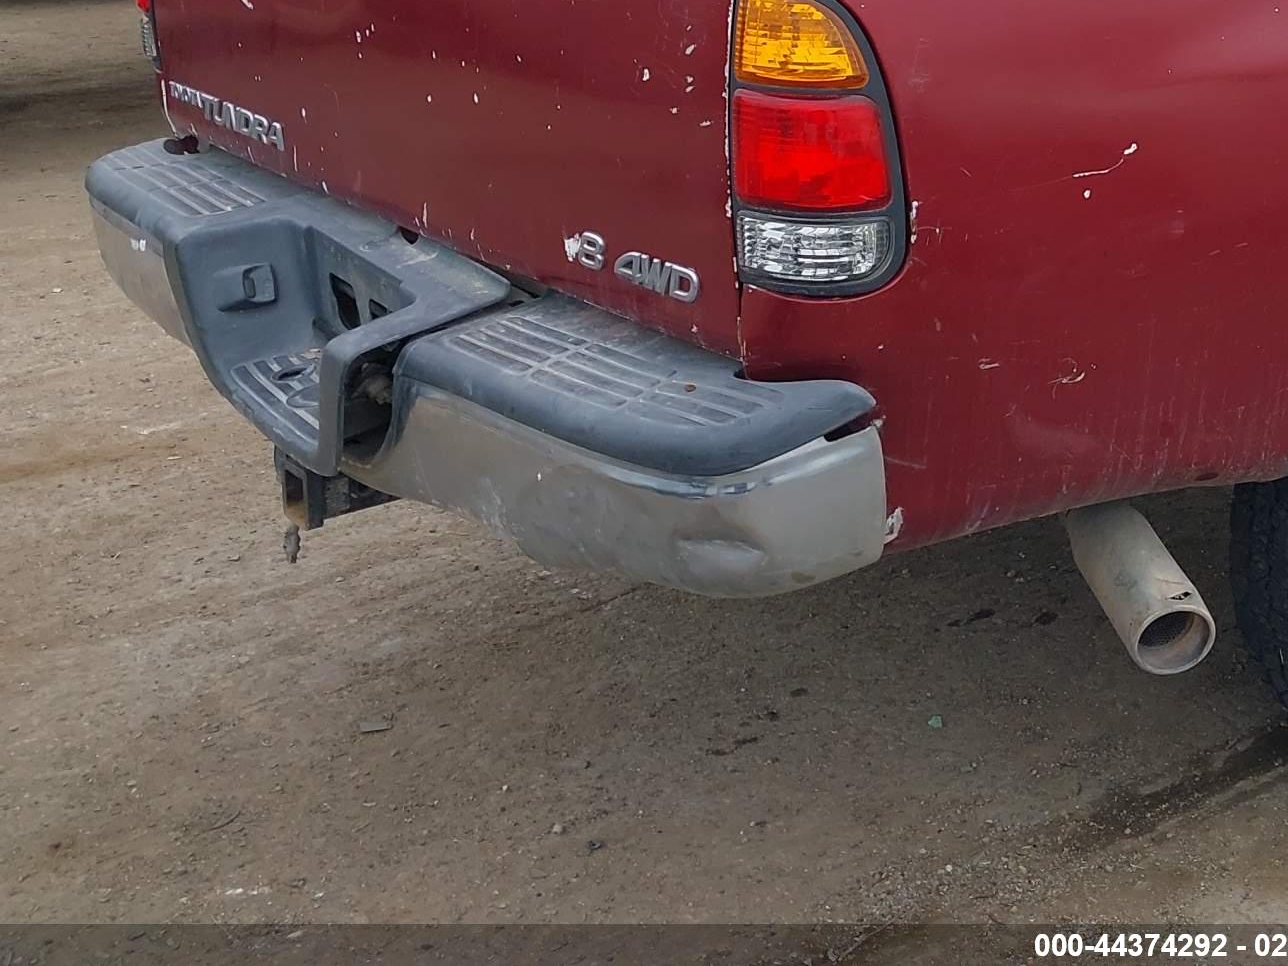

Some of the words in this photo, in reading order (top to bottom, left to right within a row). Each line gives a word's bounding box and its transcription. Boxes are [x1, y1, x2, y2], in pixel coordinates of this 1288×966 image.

[201, 93, 284, 151] TUNDRA
[564, 231, 605, 270] 8
[614, 251, 699, 303] 4WD
